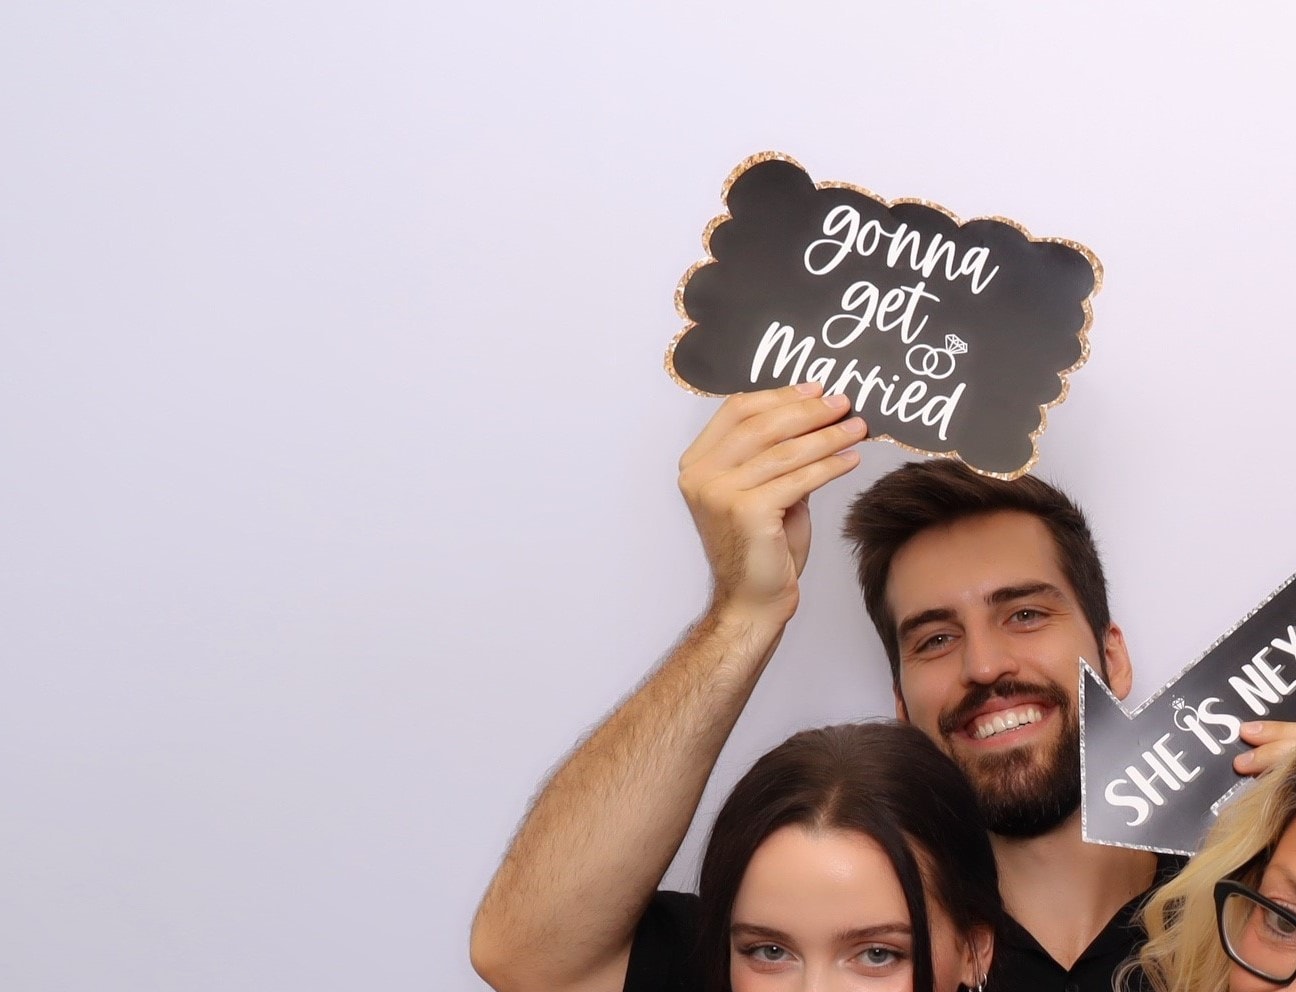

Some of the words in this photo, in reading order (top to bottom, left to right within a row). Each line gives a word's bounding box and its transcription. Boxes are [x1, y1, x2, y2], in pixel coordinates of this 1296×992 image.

[804, 205, 999, 294] gonna
[822, 281, 940, 348] get
[750, 321, 966, 440] Married
[1104, 733, 1202, 826] SHE
[1183, 697, 1241, 755] IS
